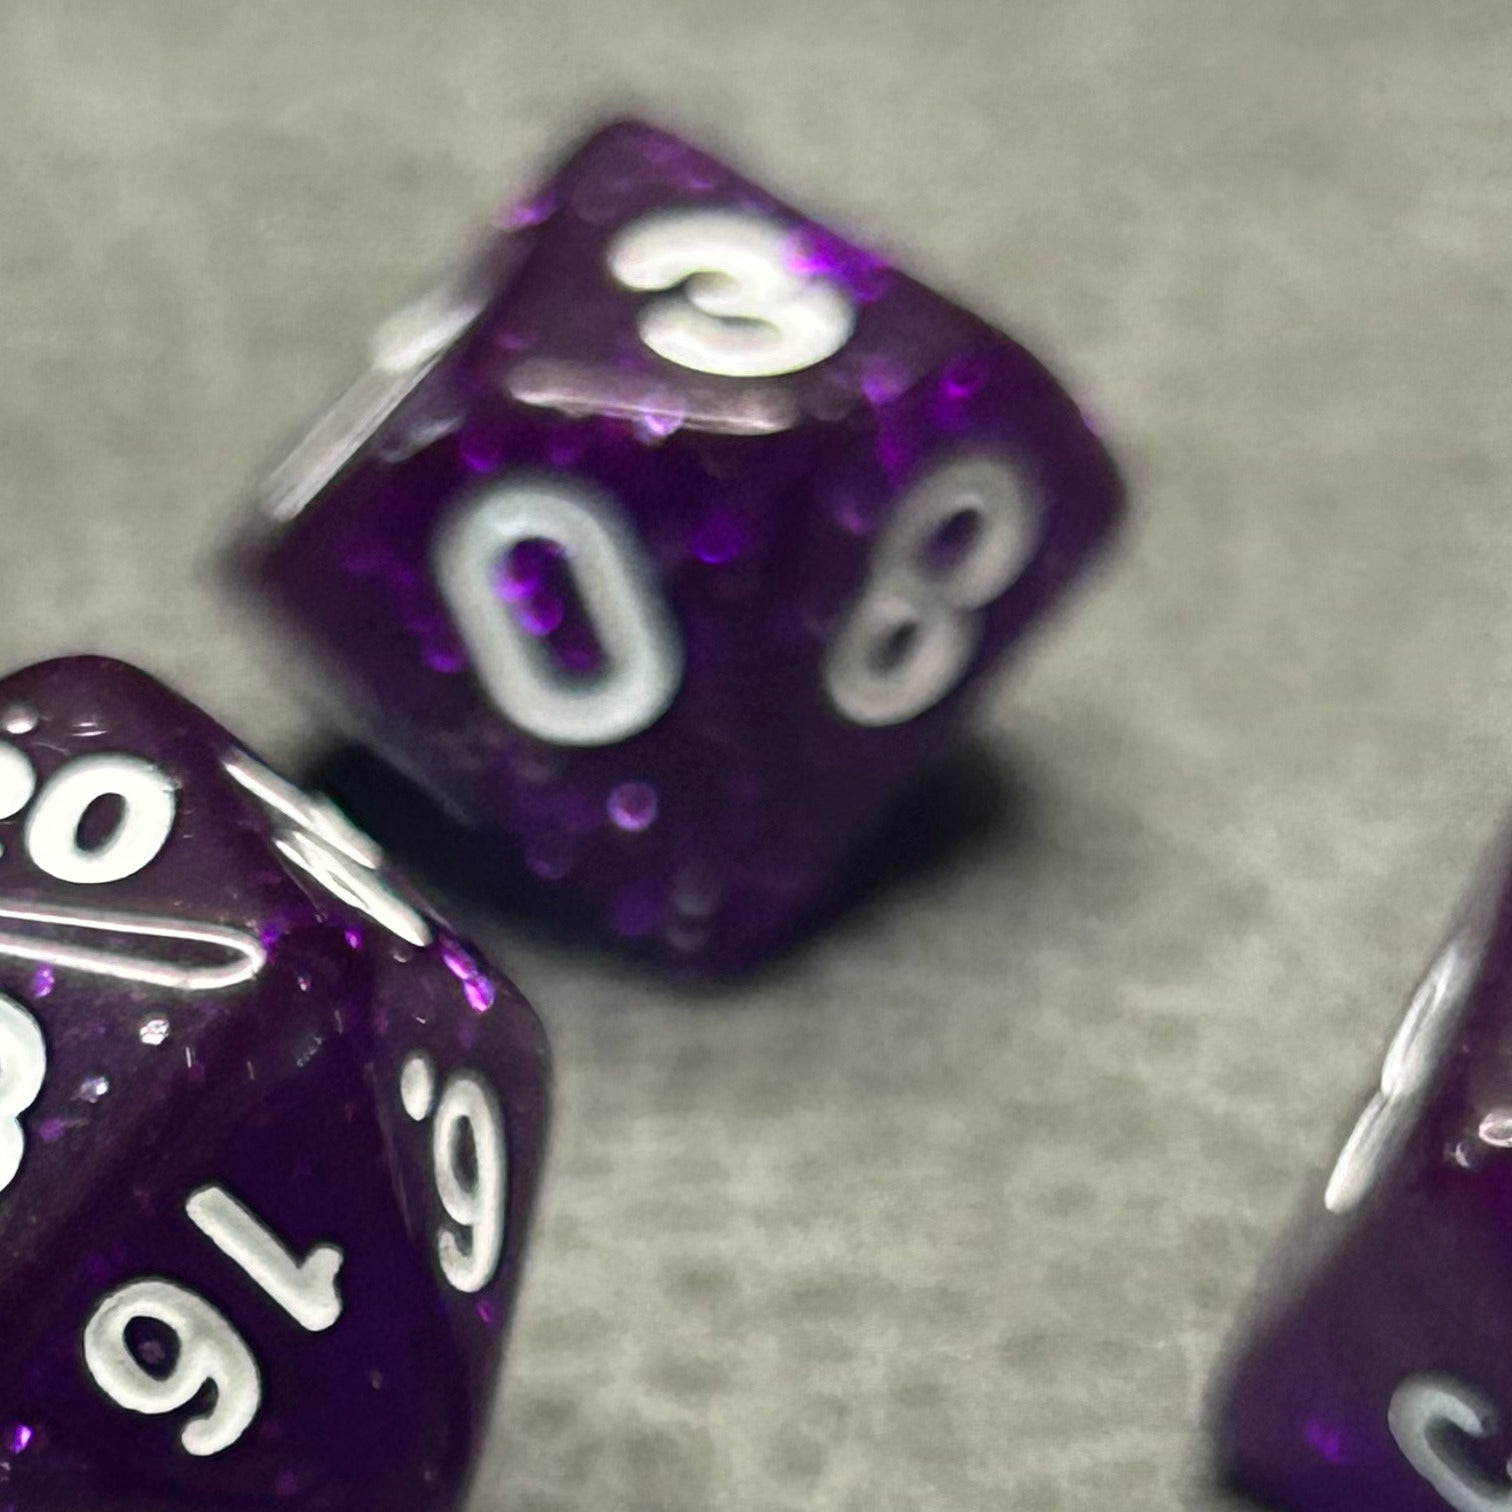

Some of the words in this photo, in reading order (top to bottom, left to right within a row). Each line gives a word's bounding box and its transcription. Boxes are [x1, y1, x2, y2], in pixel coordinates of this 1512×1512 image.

[606, 208, 856, 378] 3
[436, 478, 680, 748] 0
[823, 452, 1038, 728] 8
[82, 1184, 346, 1457] 16
